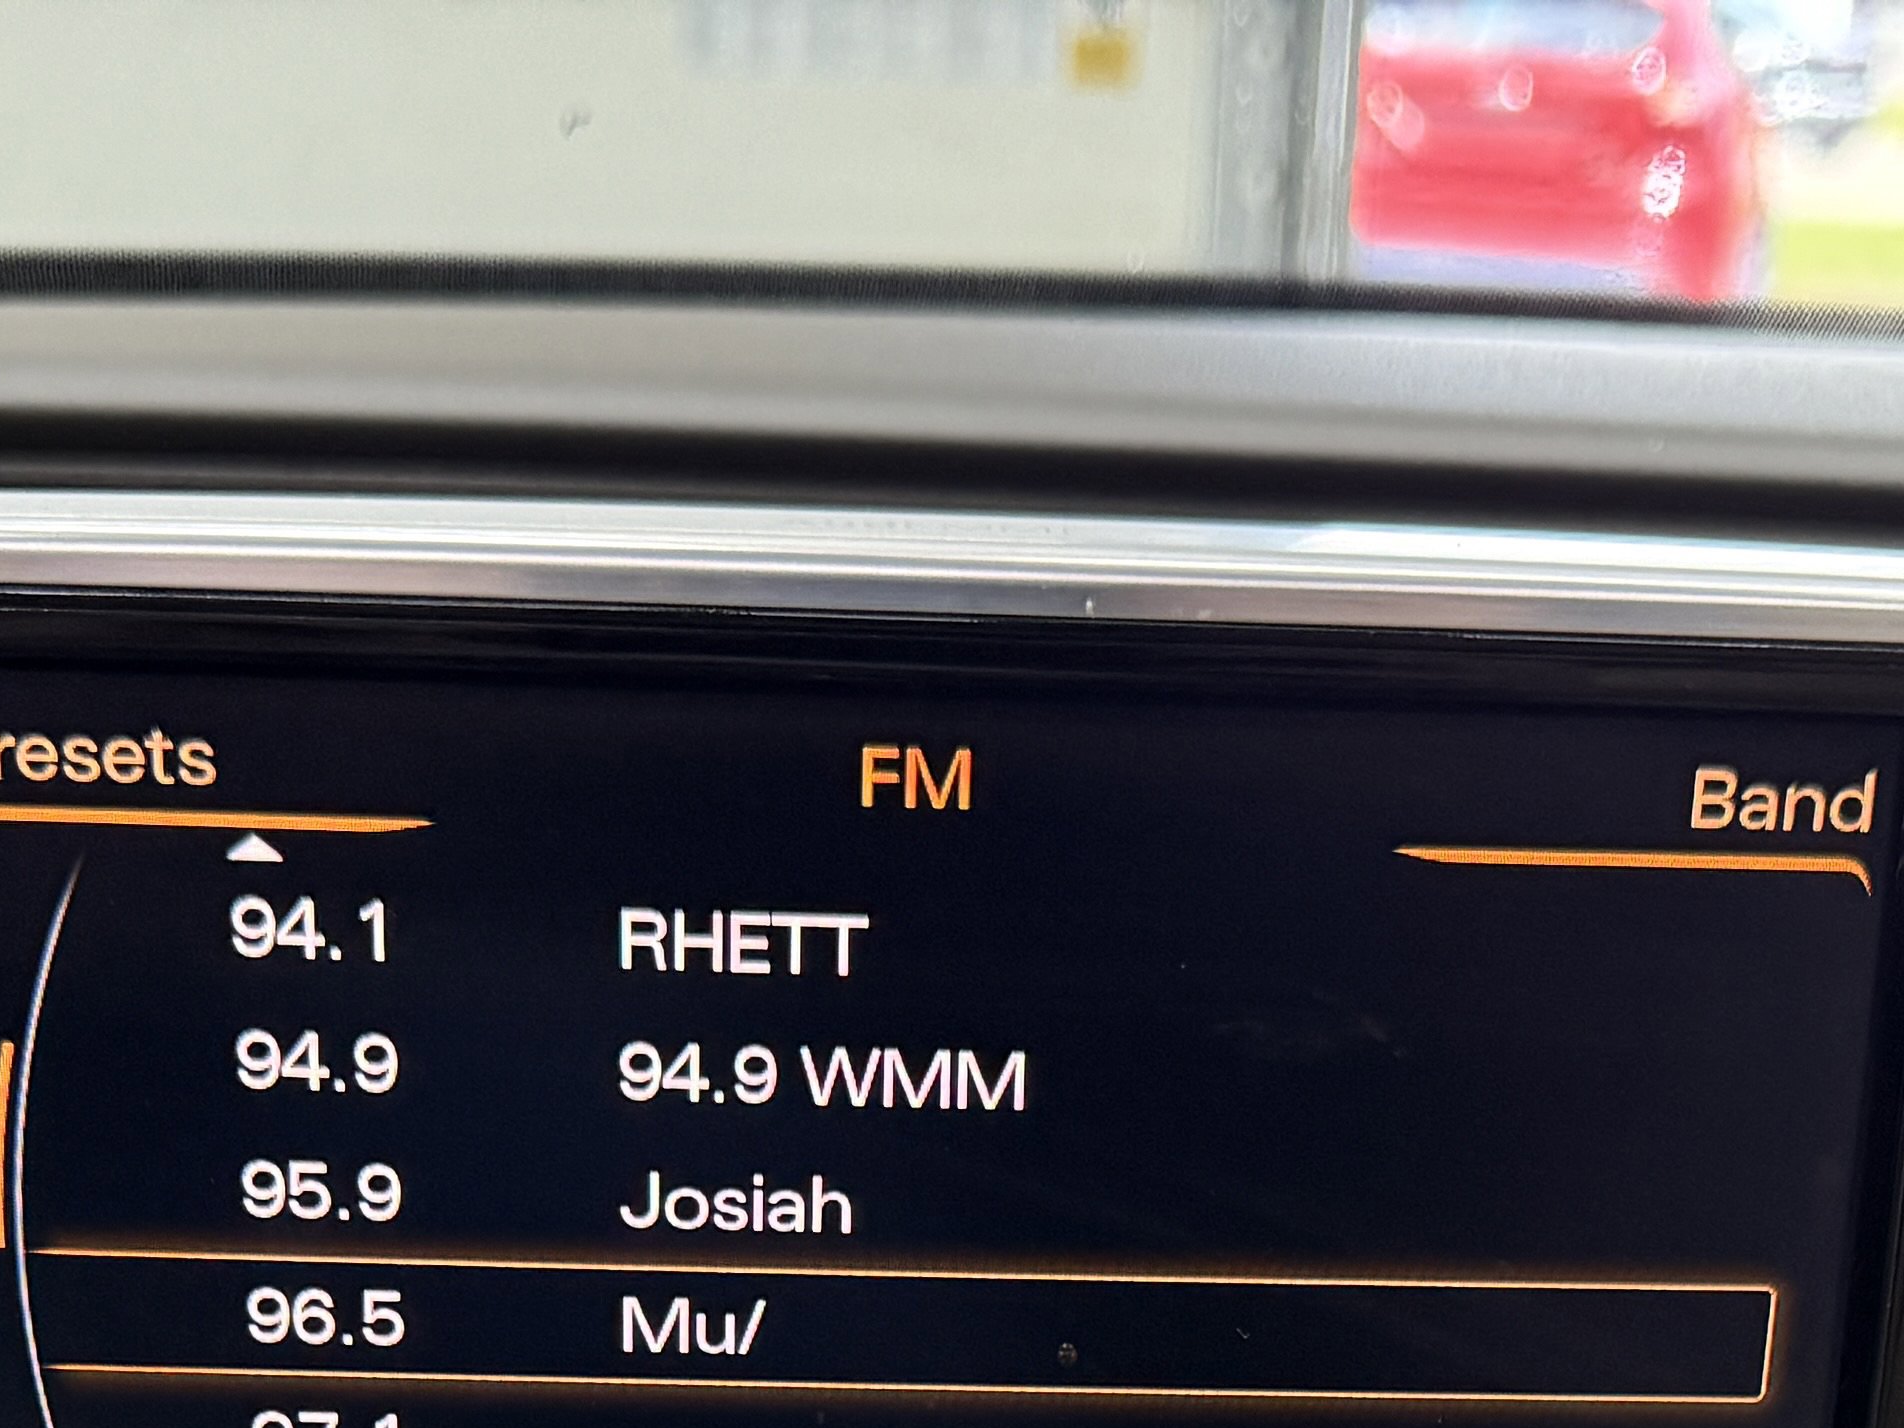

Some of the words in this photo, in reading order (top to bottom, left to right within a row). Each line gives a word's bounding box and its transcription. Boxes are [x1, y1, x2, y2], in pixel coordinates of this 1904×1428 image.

[860, 744, 973, 811] FM
[1689, 766, 1877, 834] Band
[229, 893, 386, 963] 94.1
[619, 905, 870, 977] RHETT
[234, 1027, 399, 1094] 94.9
[617, 1039, 779, 1105] 94.9
[799, 1044, 1026, 1111] WMM
[239, 1158, 402, 1222] 95.9
[619, 1169, 852, 1235] Josiah
[246, 1286, 405, 1347] 96.5
[621, 1295, 767, 1356] Mu/
